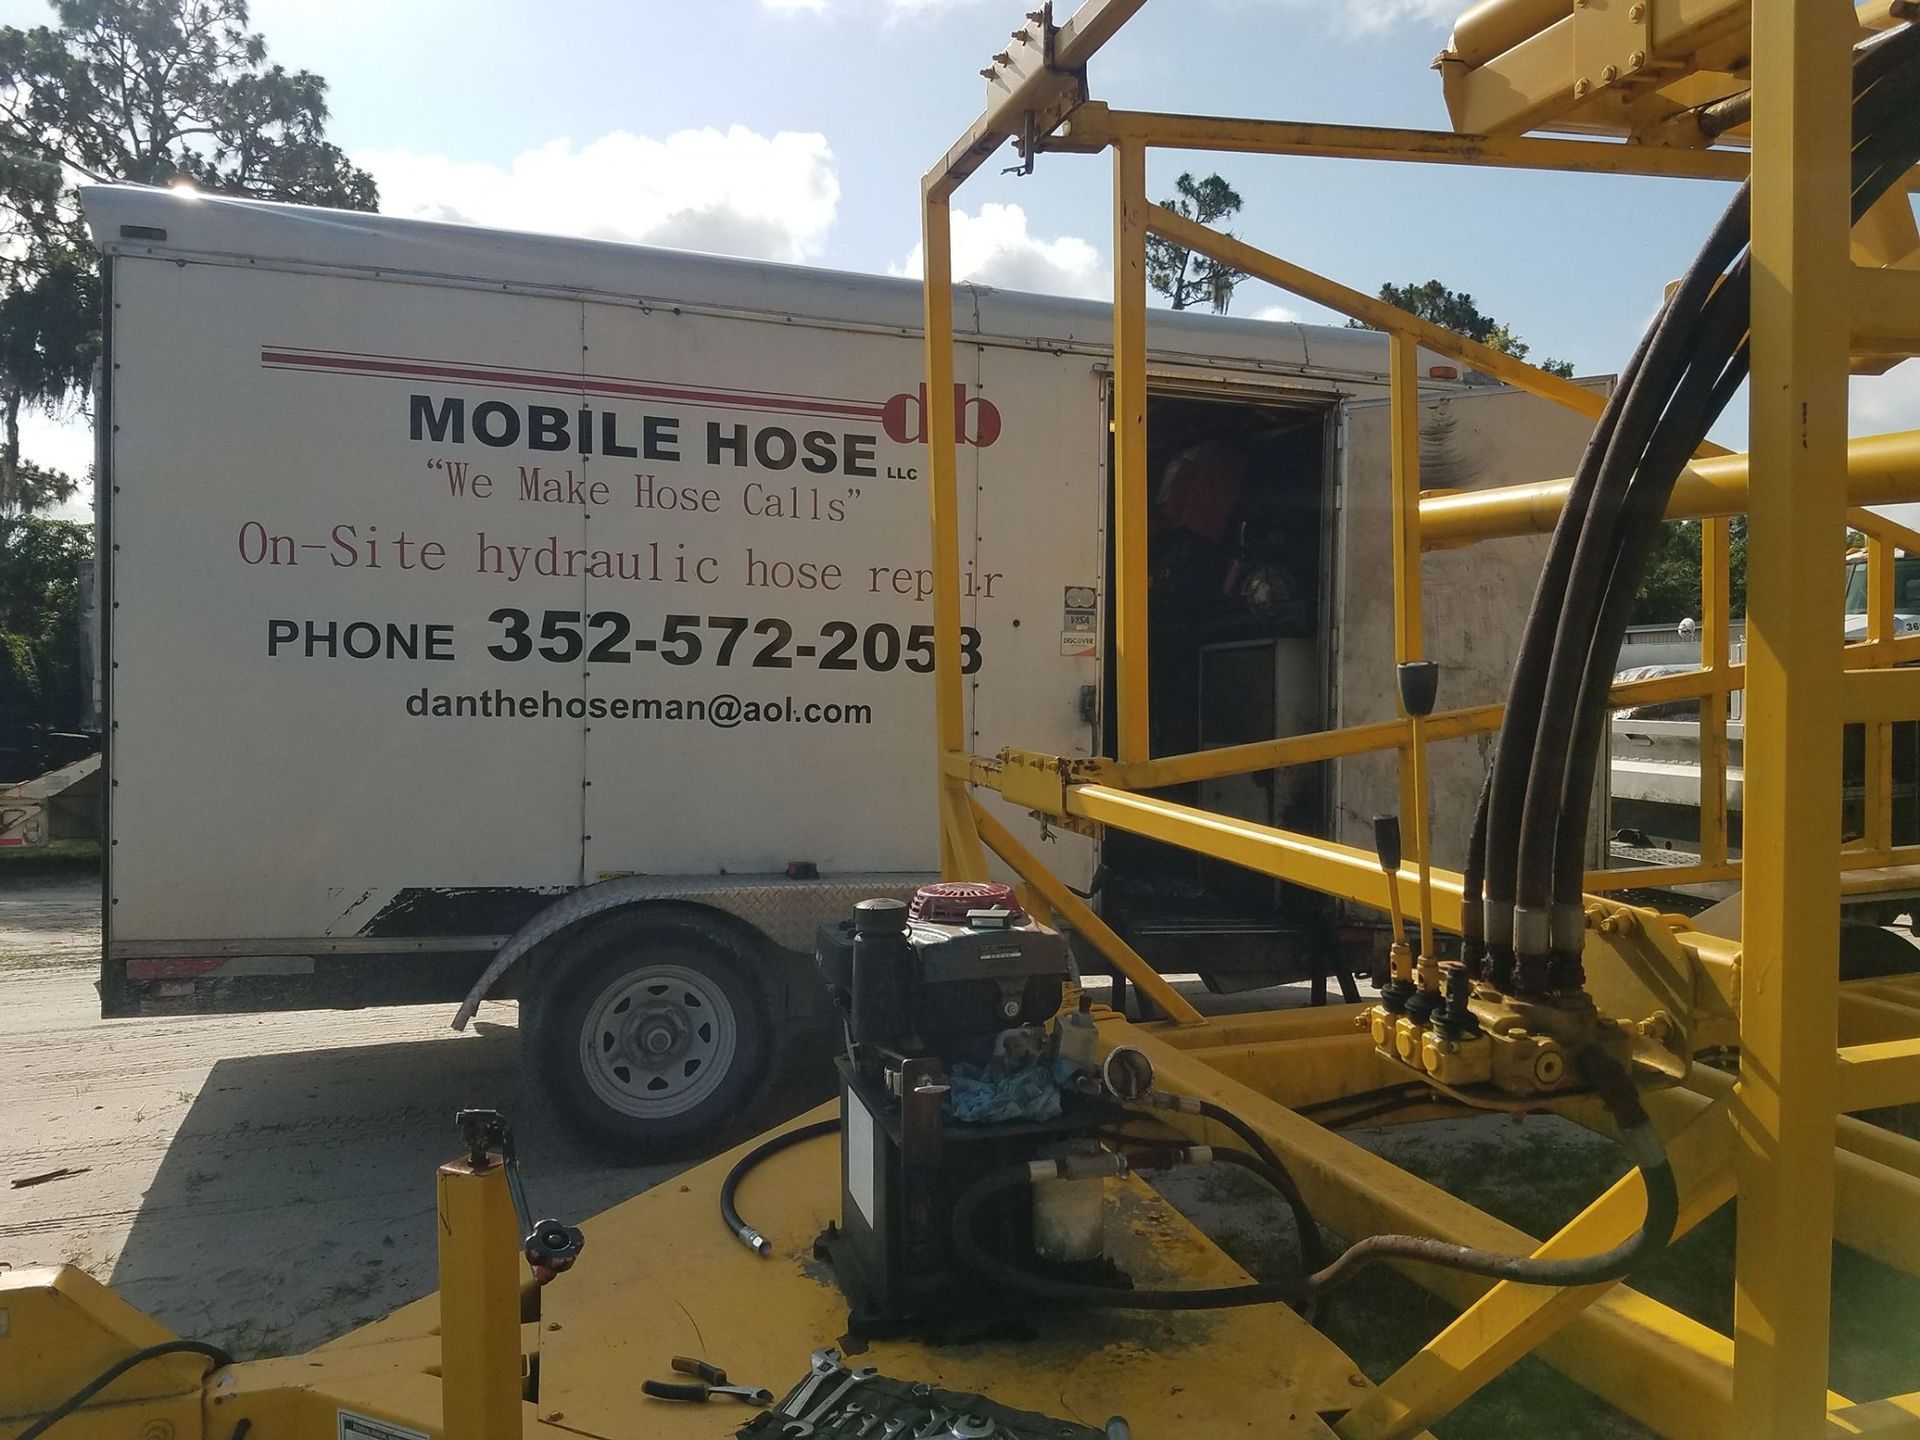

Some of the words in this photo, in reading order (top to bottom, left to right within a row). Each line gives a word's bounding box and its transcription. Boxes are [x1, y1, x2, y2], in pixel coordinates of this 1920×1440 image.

[409, 394, 681, 462] MOBILE
[706, 421, 877, 477] HOSE
[887, 466, 918, 481] LLC
[518, 466, 610, 505] Make
[634, 474, 721, 513] Hose
[238, 521, 447, 571] On-Site
[477, 532, 720, 584] hydraulic
[745, 548, 842, 591] hose
[868, 560, 1003, 601] repir
[268, 619, 456, 661] PHONE
[1070, 615, 1090, 625] VISA
[1906, 622, 1920, 632] 36
[405, 688, 872, 728] danthehoseman@aol.com
